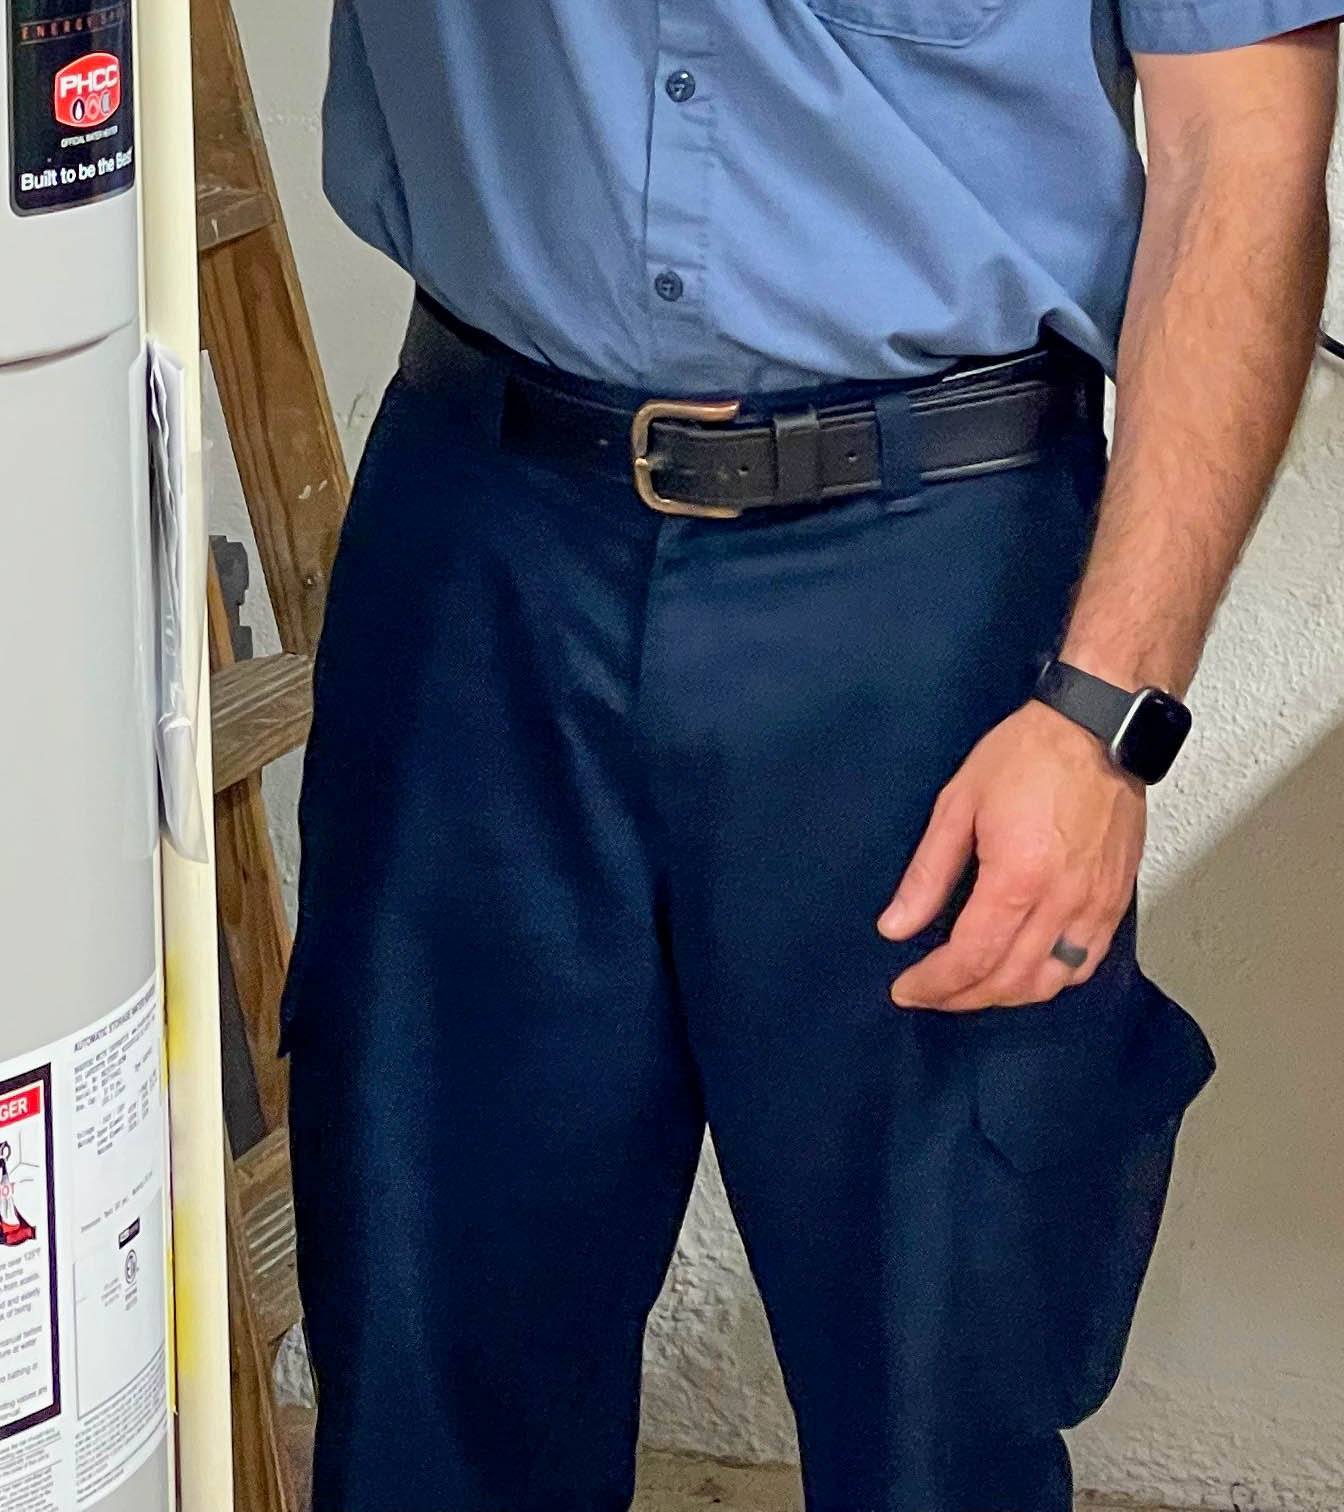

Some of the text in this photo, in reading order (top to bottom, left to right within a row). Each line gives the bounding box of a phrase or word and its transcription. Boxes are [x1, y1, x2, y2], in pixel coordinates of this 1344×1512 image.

[60, 64, 118, 99] PHCC
[20, 166, 58, 192] Built
[60, 167, 77, 184] to
[78, 163, 96, 180] be
[97, 157, 115, 176] the
